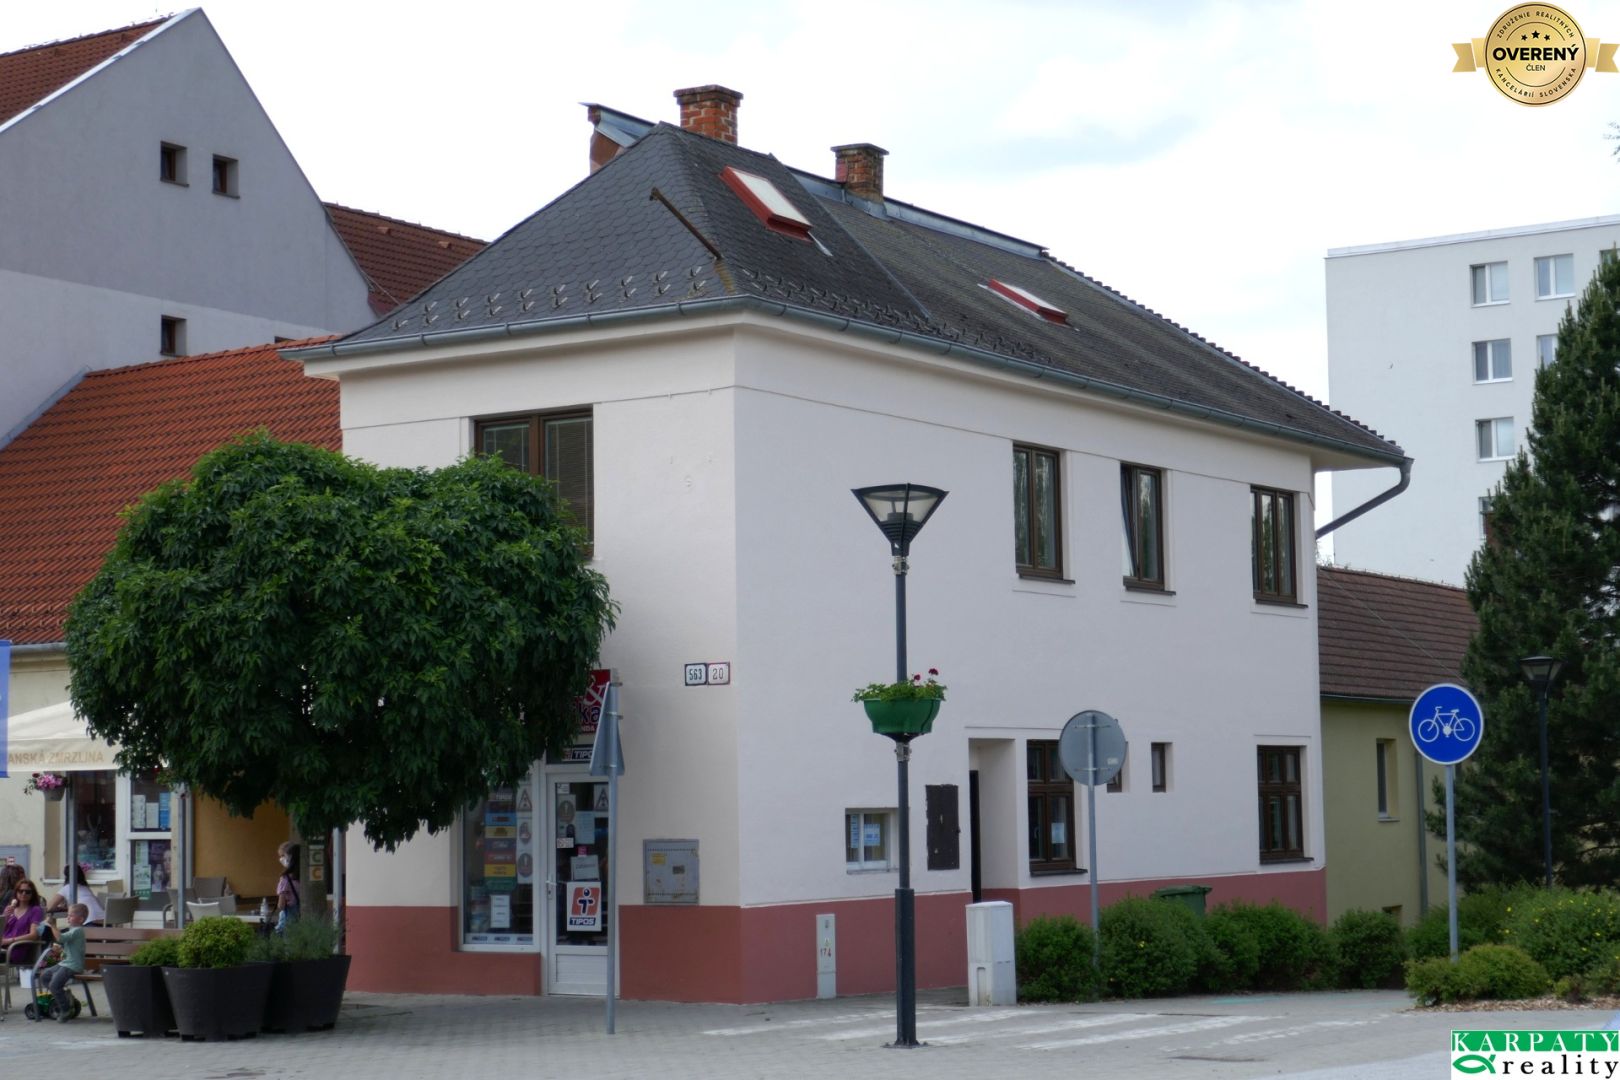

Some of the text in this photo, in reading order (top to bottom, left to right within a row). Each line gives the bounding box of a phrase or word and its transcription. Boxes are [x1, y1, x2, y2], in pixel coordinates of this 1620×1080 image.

[689, 668, 703, 681] 563
[712, 667, 724, 680] 20
[570, 917, 595, 926] TIPOS
